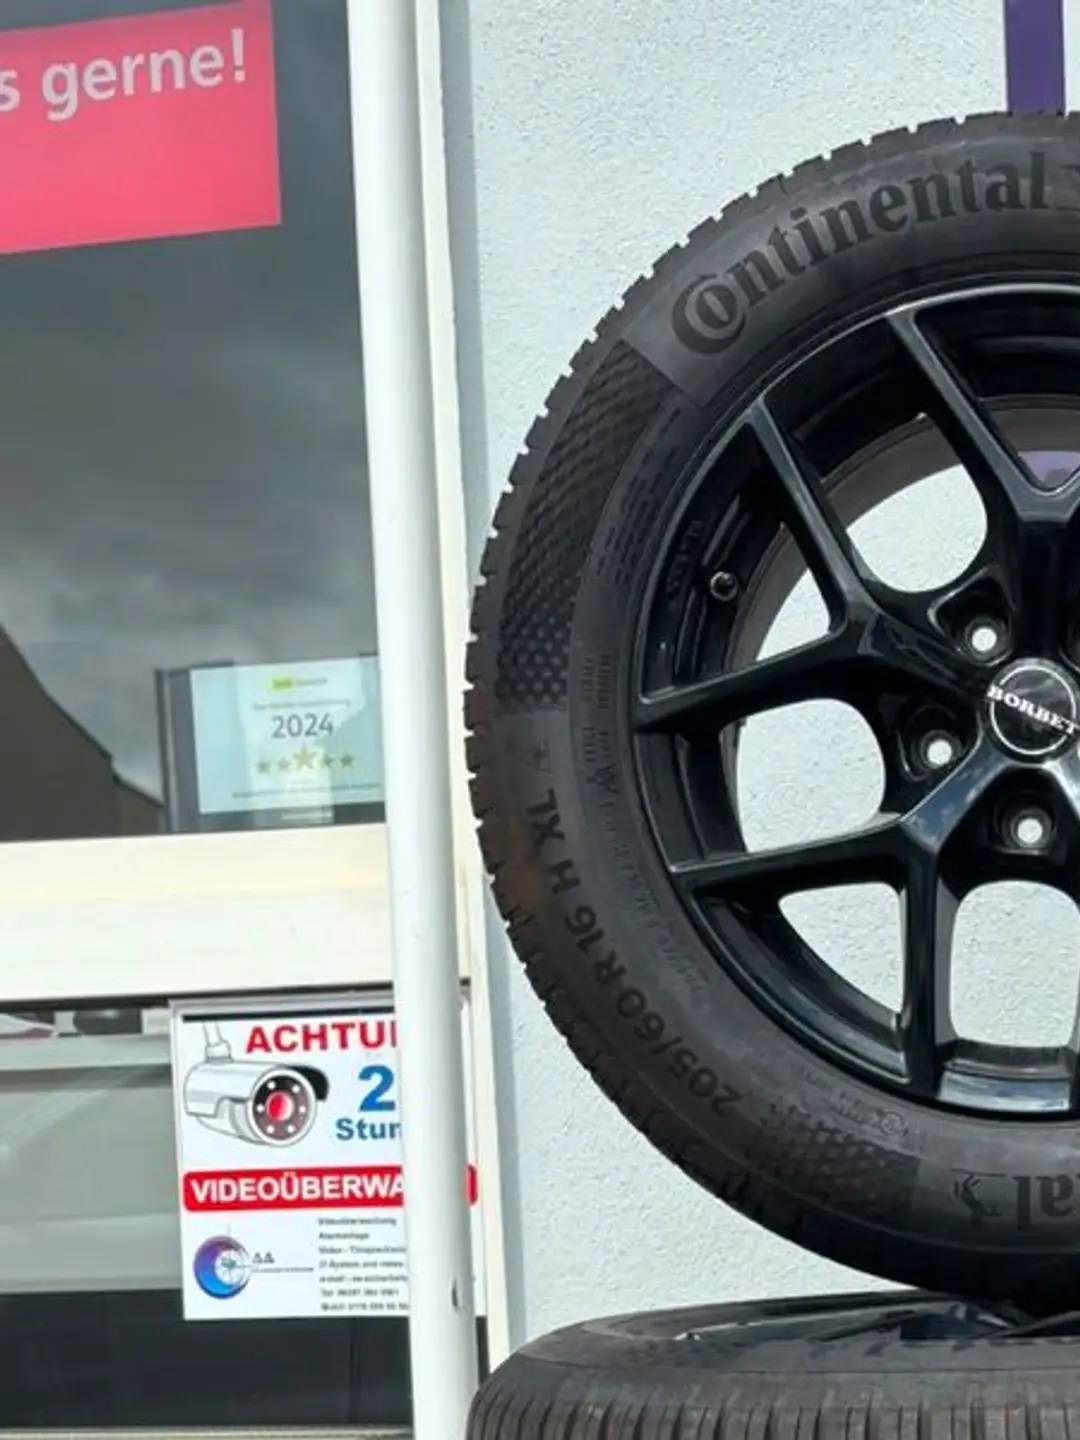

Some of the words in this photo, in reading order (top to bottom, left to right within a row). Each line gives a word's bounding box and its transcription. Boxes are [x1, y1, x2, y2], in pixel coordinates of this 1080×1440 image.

[41, 27, 247, 122] gerne!
[670, 150, 1048, 354] Continental
[271, 711, 335, 740] 2024
[986, 684, 1080, 735] BORBET
[526, 788, 566, 848] XL
[546, 859, 582, 896] H
[564, 904, 605, 955] 16
[615, 987, 742, 1116] 205/60
